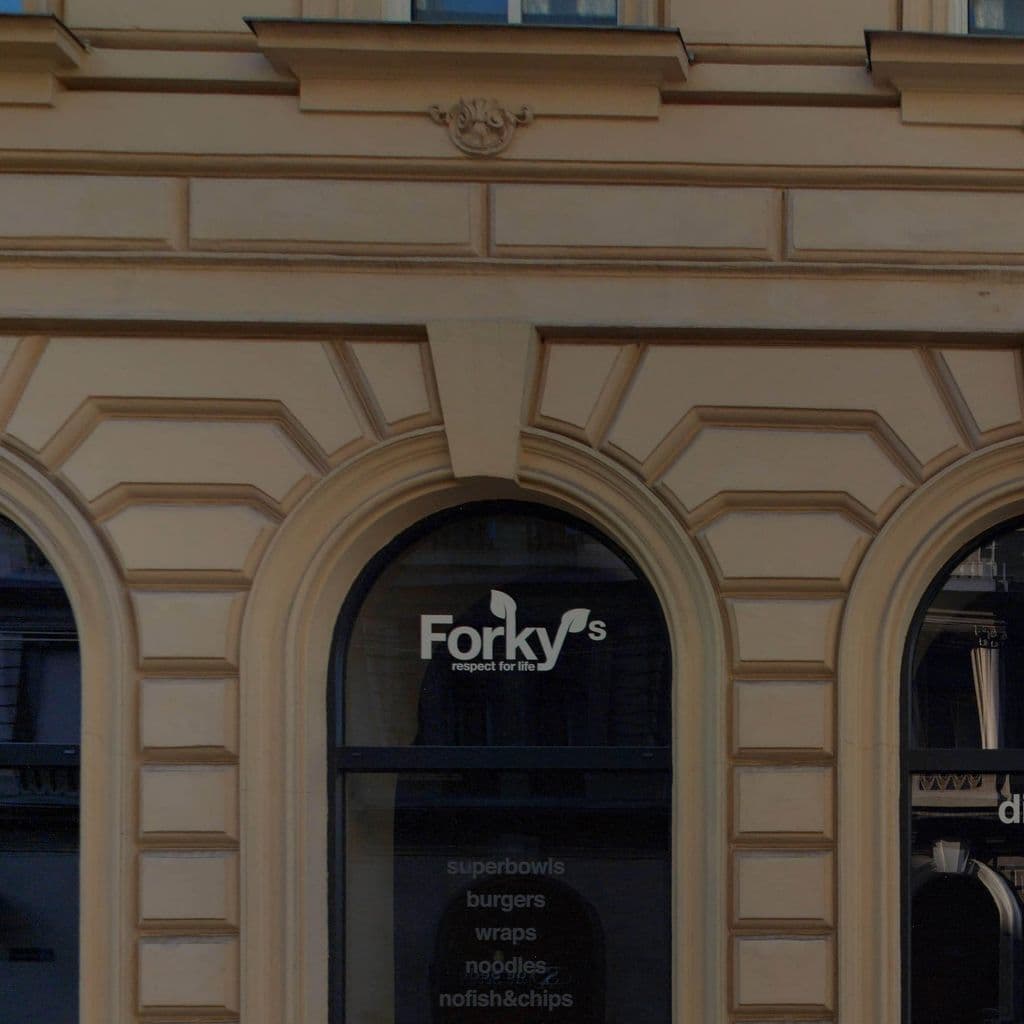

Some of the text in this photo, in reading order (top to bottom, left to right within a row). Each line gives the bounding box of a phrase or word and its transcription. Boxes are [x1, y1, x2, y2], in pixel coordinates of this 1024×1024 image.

[452, 661, 535, 673] respect for life
[447, 857, 566, 879] superbowls
[466, 890, 546, 912] burgers
[475, 927, 537, 945] wraps
[465, 957, 547, 974] noodles
[439, 989, 574, 1011] nofish&chips
